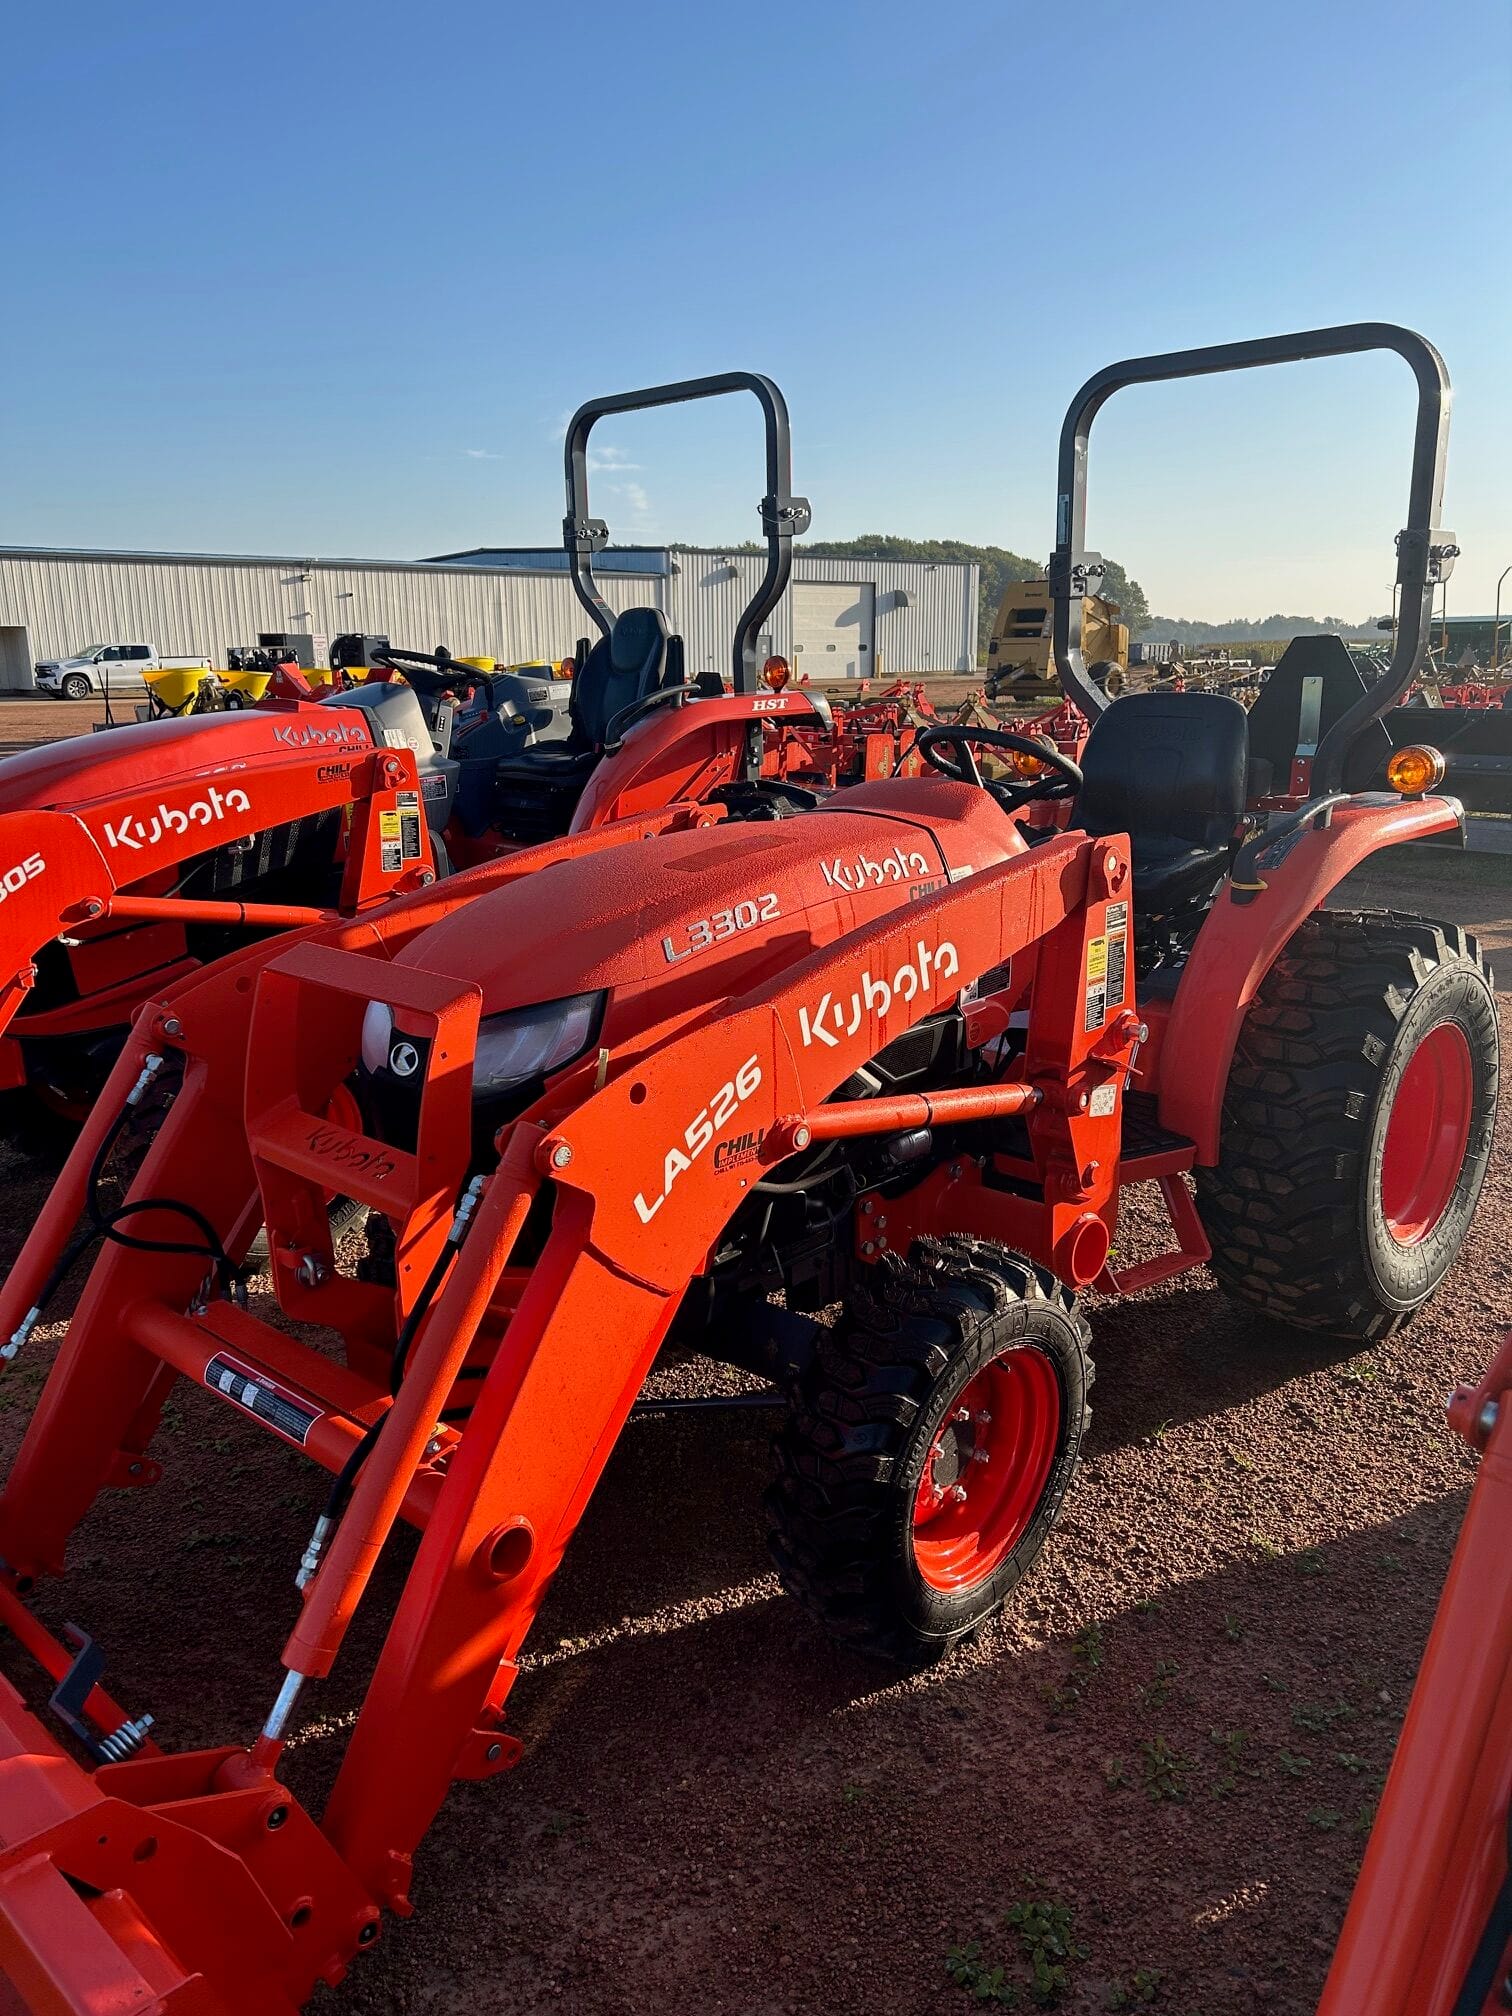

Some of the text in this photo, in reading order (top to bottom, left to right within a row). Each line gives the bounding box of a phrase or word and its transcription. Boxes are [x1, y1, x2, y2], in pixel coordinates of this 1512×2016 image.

[273, 721, 367, 747] Kubota
[752, 698, 789, 712] HST
[103, 786, 251, 850] Kubota
[819, 847, 930, 891] Kubota
[661, 892, 782, 963] L3302
[798, 940, 959, 1048] Kubota
[304, 1125, 396, 1179] Kubota
[633, 1053, 762, 1225] LA526
